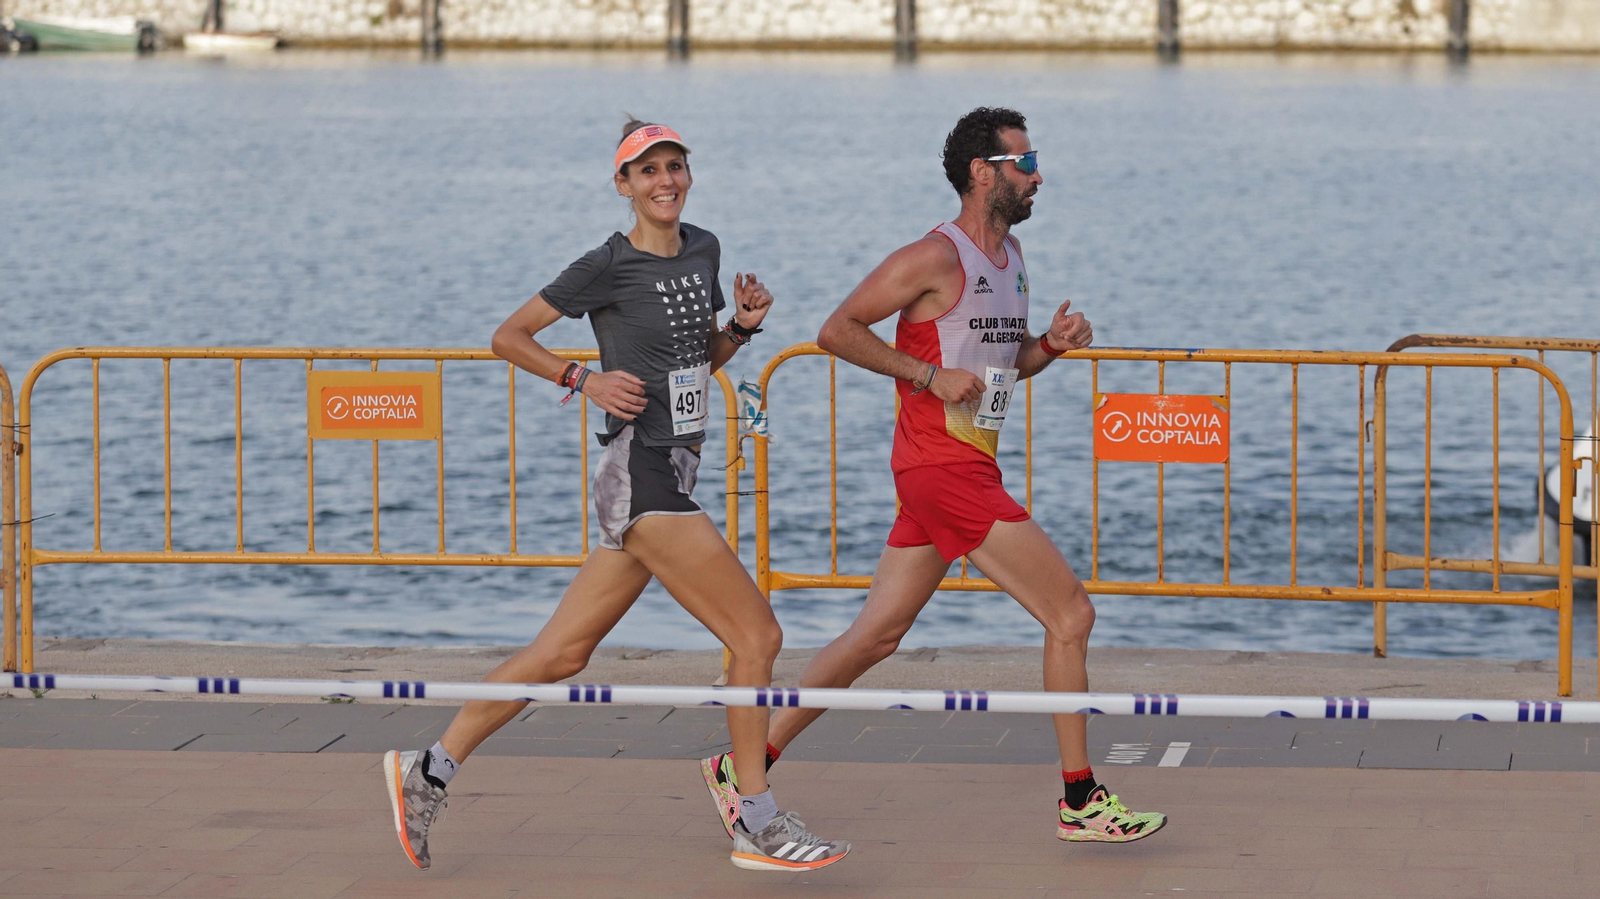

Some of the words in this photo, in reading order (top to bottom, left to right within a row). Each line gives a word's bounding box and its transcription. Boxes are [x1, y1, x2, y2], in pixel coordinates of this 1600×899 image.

[656, 274, 702, 292] NIKE
[969, 317, 999, 330] CLUB
[674, 375, 685, 386] XX
[352, 395, 417, 407] INNOVIA
[676, 389, 702, 416] 497
[353, 408, 417, 420] COPTALIA
[1136, 411, 1222, 428] INNOVIA
[1136, 429, 1222, 446] COPTALIA
